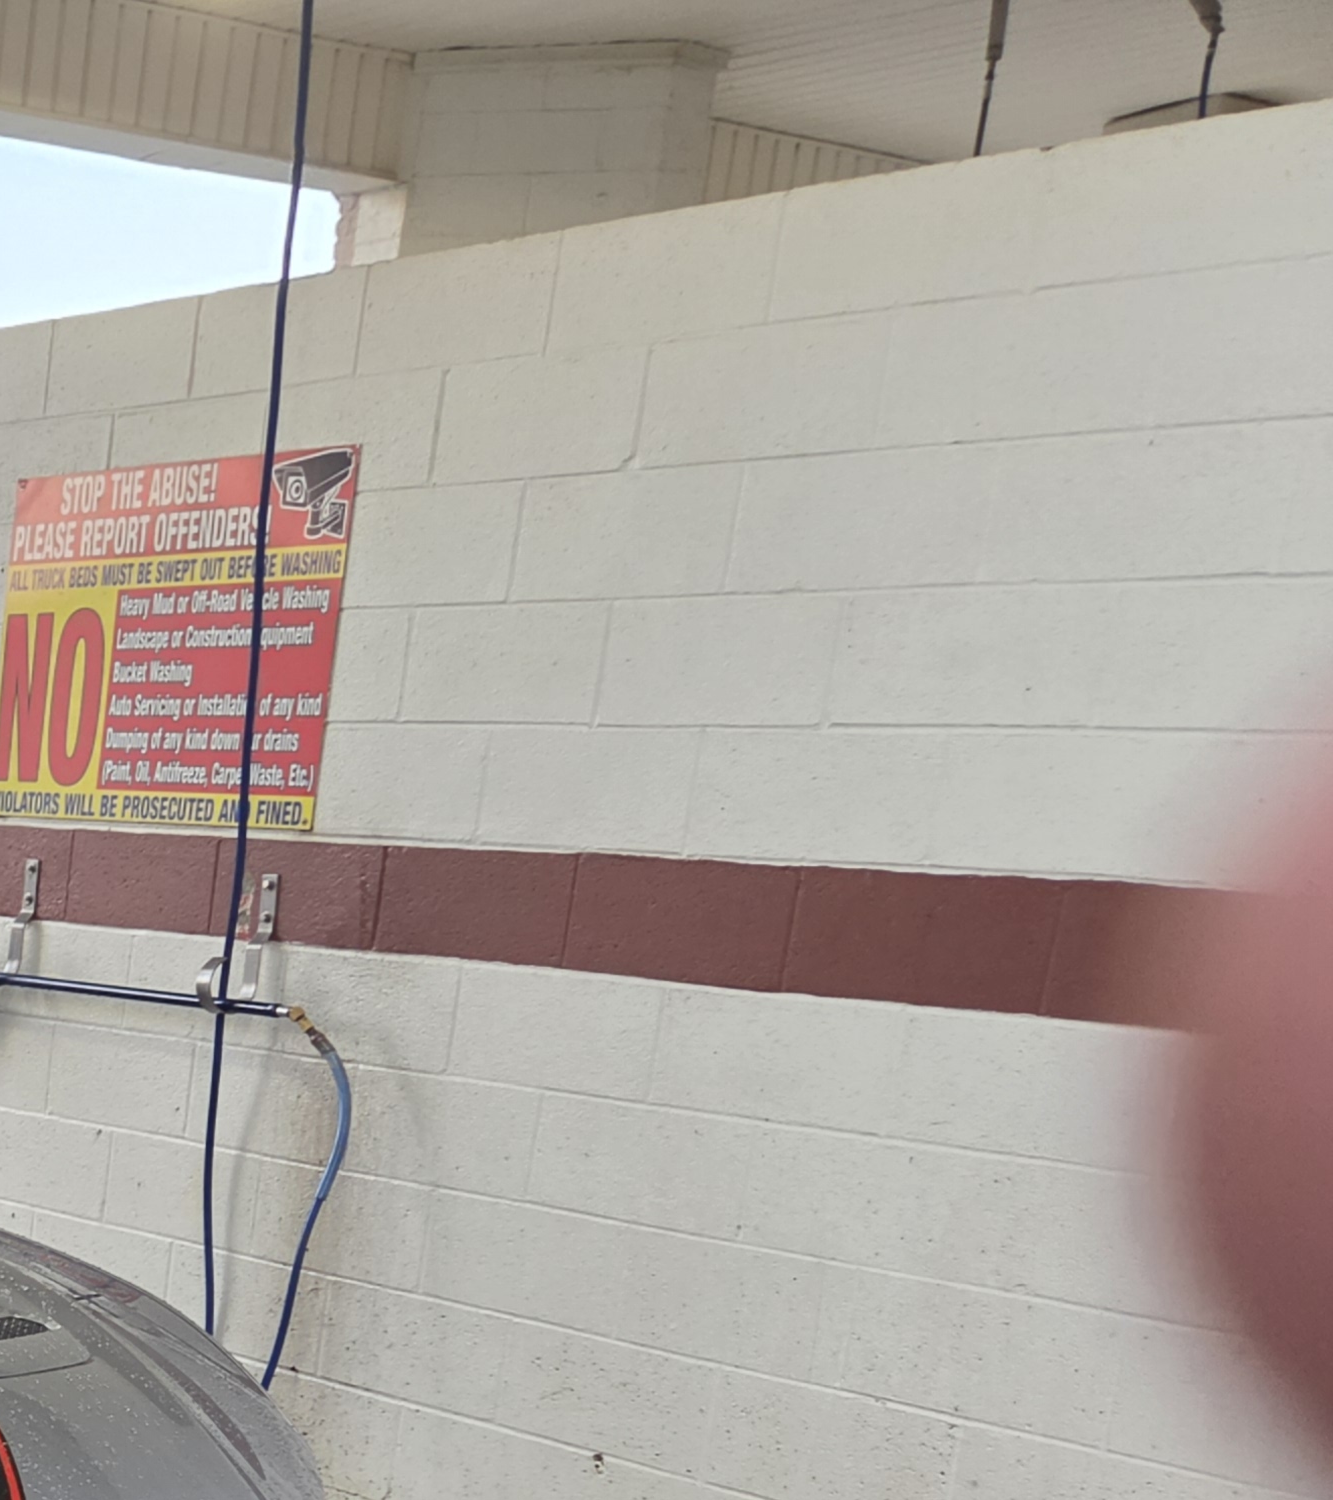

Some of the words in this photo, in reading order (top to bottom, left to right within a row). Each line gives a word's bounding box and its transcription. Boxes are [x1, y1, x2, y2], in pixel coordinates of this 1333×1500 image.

[60, 474, 105, 515] STOP
[111, 468, 142, 511] THE
[147, 462, 218, 509] ABUSE!
[12, 520, 76, 562] PLEASE
[80, 514, 150, 557] REPORT
[9, 570, 29, 591] ALL
[31, 567, 66, 590] TRUCK
[68, 564, 98, 588] BEDS
[101, 562, 134, 587] MUST
[137, 561, 152, 584] BE
[155, 558, 198, 583] SWEPT
[200, 556, 226, 581] OUT
[280, 549, 342, 577] WASHING
[119, 594, 150, 620] Heavy
[152, 592, 174, 615] Mud
[177, 595, 189, 614] or
[191, 590, 237, 613] Off-Road
[241, 588, 279, 611] Vecle
[282, 586, 330, 613] Washing
[116, 628, 169, 653] Landscape
[171, 630, 184, 647] or
[185, 625, 252, 647] Construction
[260, 622, 314, 650] quipment
[112, 661, 148, 683] Bucket
[150, 660, 193, 686] Washing
[109, 694, 131, 716] Auto
[134, 693, 181, 721] Servicing
[183, 698, 195, 716] or
[197, 693, 247, 716] Installati
[259, 693, 274, 717] of
[272, 698, 295, 721] any
[296, 693, 322, 716] kind
[105, 728, 149, 754] Dumping
[151, 728, 164, 749] of
[163, 732, 184, 754] any
[185, 728, 212, 750] kind
[211, 729, 240, 751] down
[264, 729, 300, 751] drains
[102, 760, 131, 786] (Paint,
[135, 762, 151, 786] Oil,
[153, 763, 208, 788] Antifreeze,
[211, 763, 243, 789] Carpe
[250, 763, 285, 790] Waste,
[288, 763, 315, 793] Etc.)
[63, 793, 96, 817] WILL
[100, 794, 118, 818] BE
[121, 795, 213, 822] PROSECUTED
